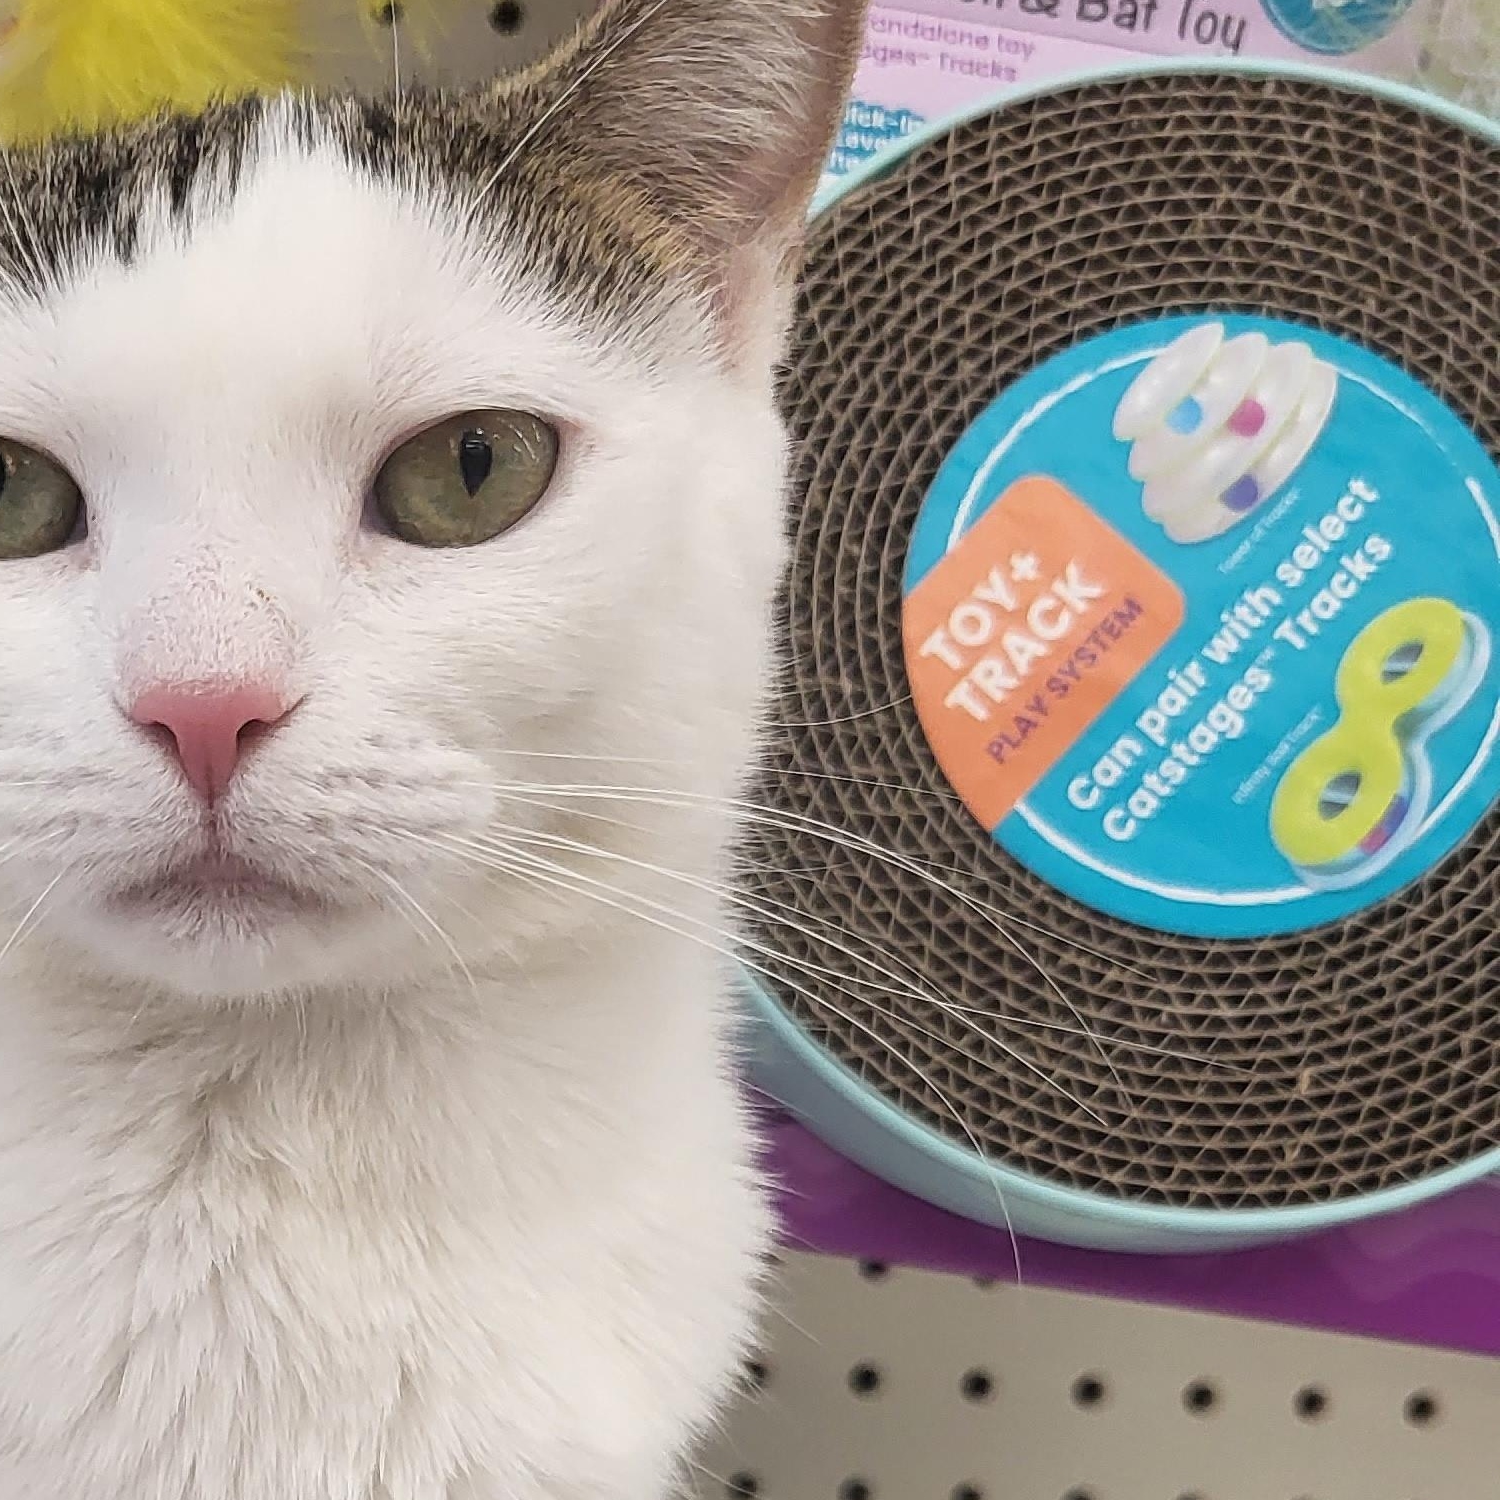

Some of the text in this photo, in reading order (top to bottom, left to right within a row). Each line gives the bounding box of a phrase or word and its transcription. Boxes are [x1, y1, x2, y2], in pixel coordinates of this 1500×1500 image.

[998, 34, 1036, 62] toy
[944, 557, 1106, 722] TRACK
[1067, 735, 1145, 810] Can
[1135, 661, 1207, 746] pair
[1201, 585, 1283, 664] with
[1275, 477, 1379, 587] select
[1273, 534, 1393, 650] Tracks
[986, 593, 1143, 764] PLAY SYSTEM
